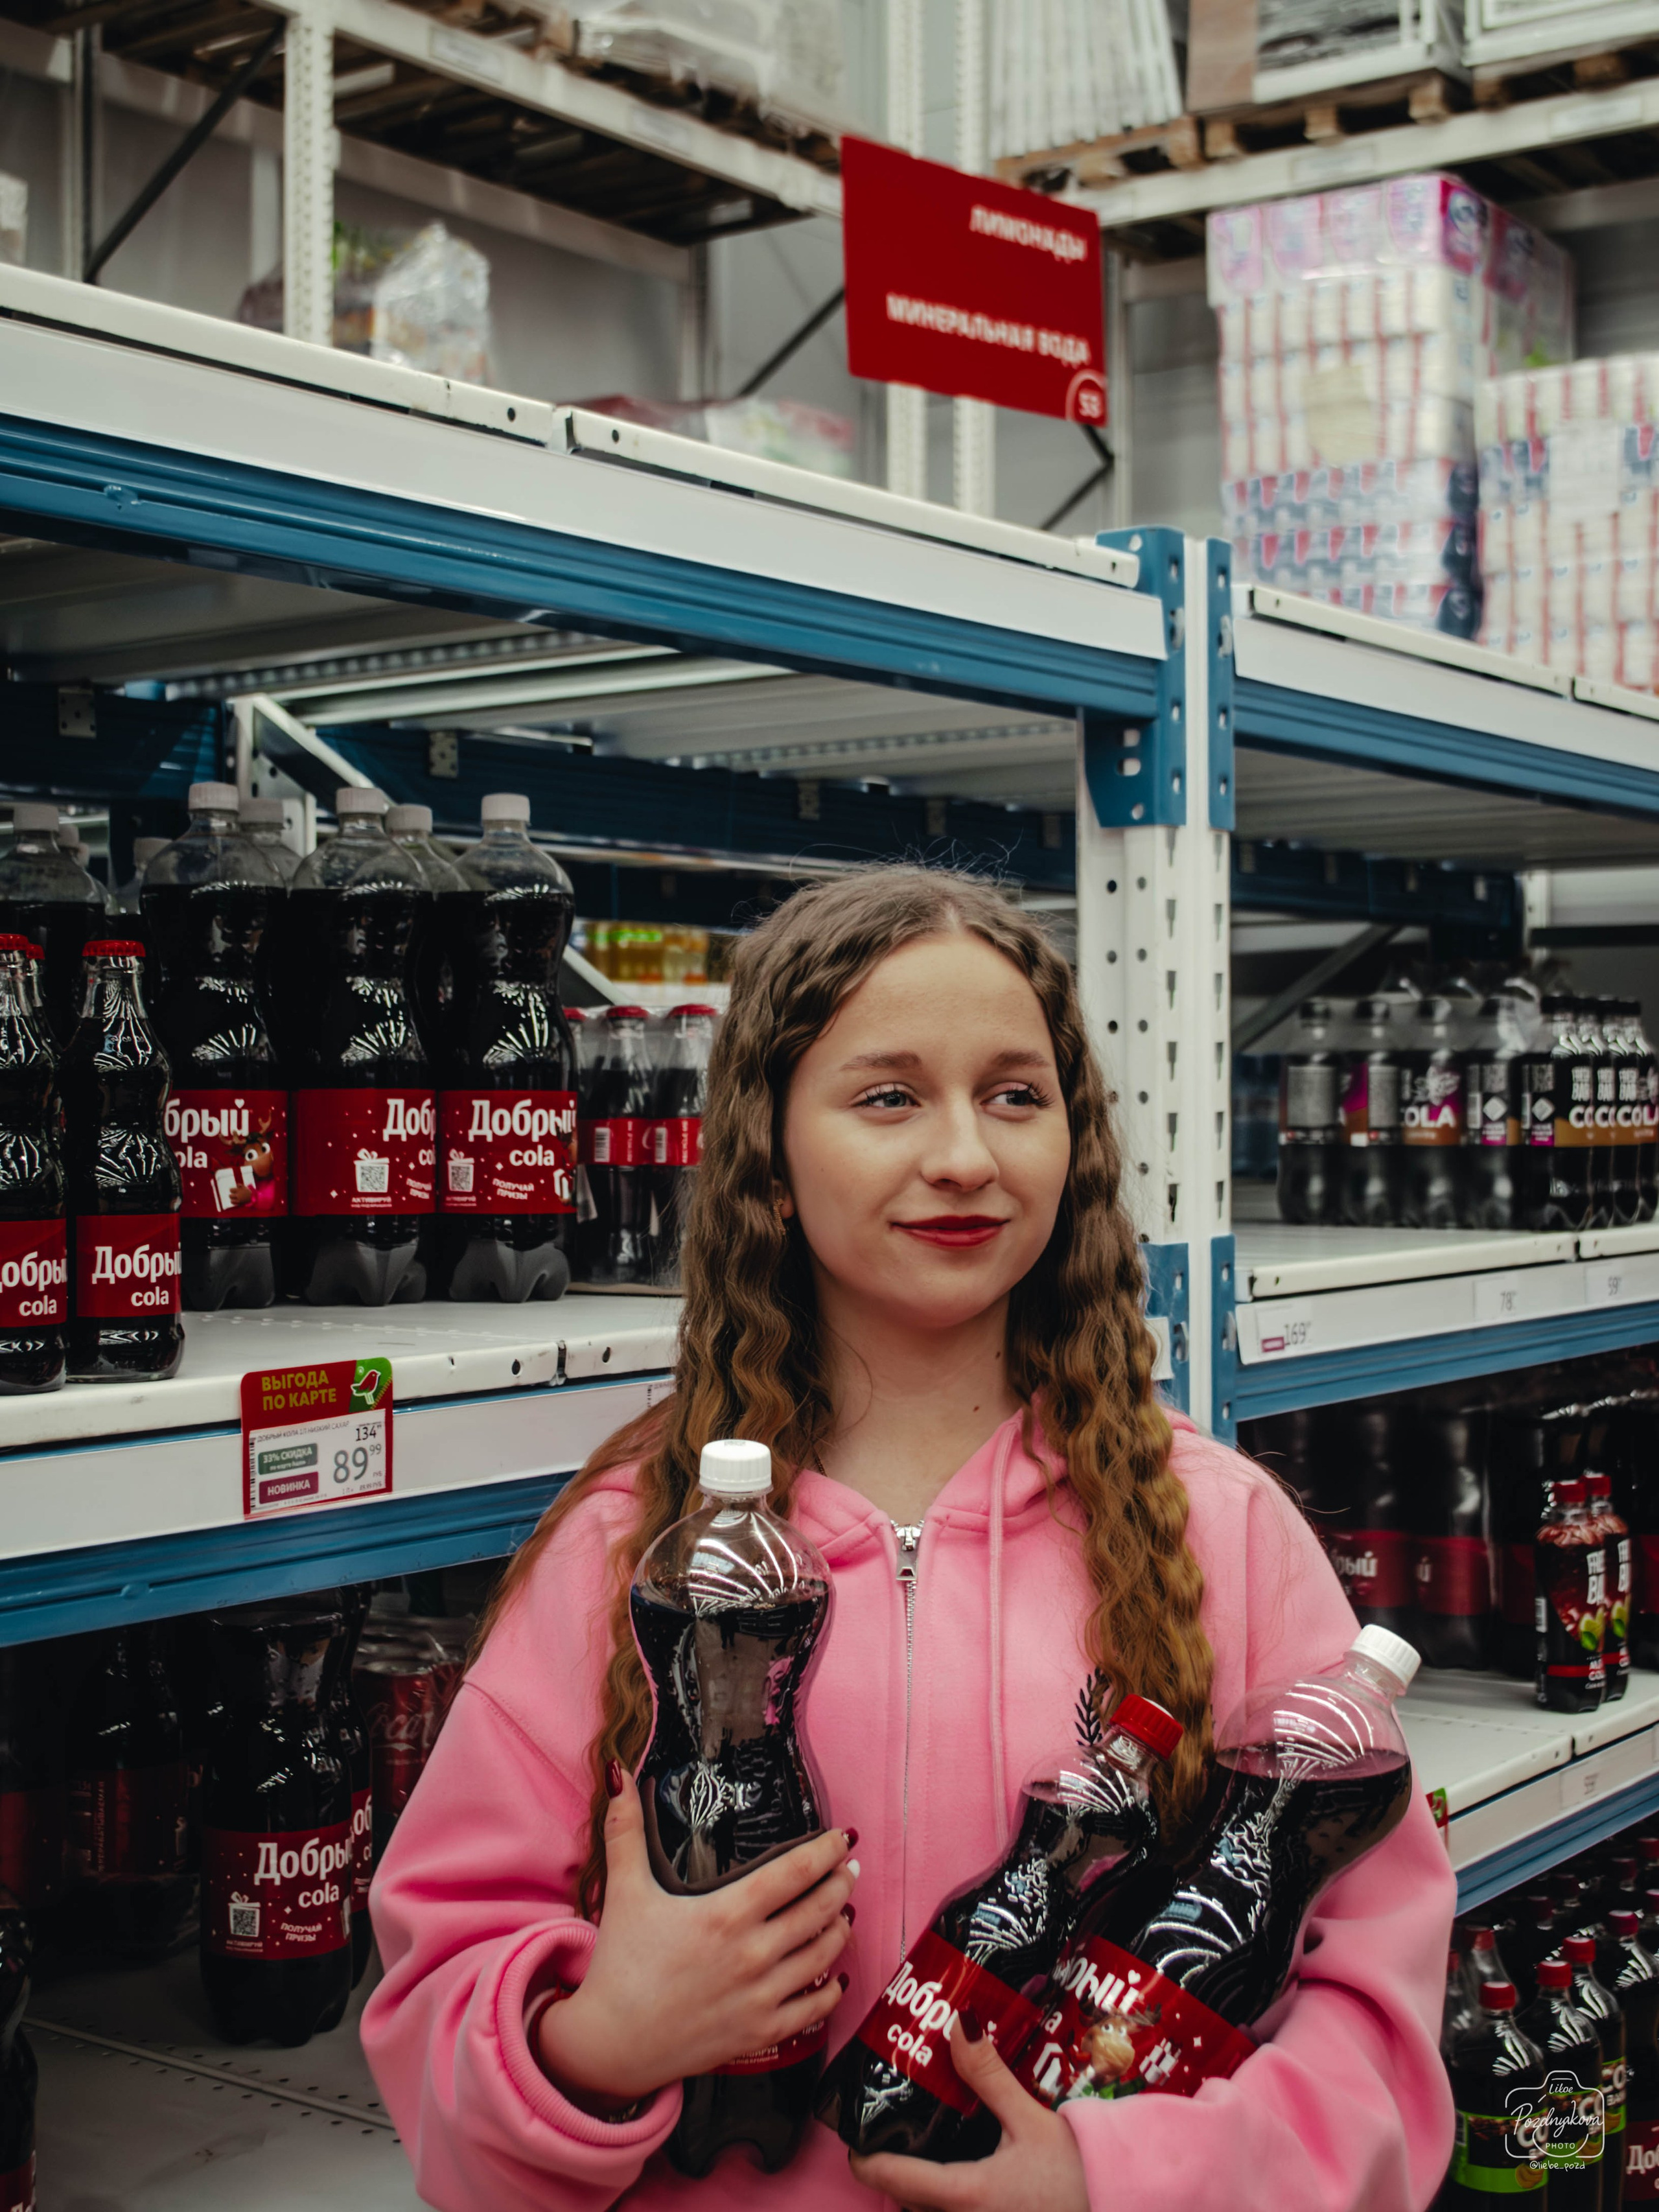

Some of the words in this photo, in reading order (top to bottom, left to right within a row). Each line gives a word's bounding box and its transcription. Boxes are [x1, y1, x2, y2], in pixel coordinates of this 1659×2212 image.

[164, 1099, 249, 1143] брый
[1400, 1104, 1456, 1128] OLA
[174, 1146, 208, 1169] ola
[509, 1145, 555, 1167] cola
[0, 1250, 67, 1293] обры
[19, 1295, 57, 1316] cola
[131, 1286, 169, 1307] cola
[261, 1369, 329, 1391] ВЫГОДА
[262, 1395, 286, 1411] ПО
[289, 1388, 337, 1408] КАРТЕ
[356, 1425, 377, 1441] 134
[333, 1447, 368, 1484] 89
[369, 1443, 382, 1456] 99
[267, 1480, 310, 1496] НОВИНКА
[253, 1837, 352, 1886] Добры
[298, 1881, 339, 1908] cola
[881, 1961, 960, 2041] Добр
[887, 2023, 933, 2067] cola
